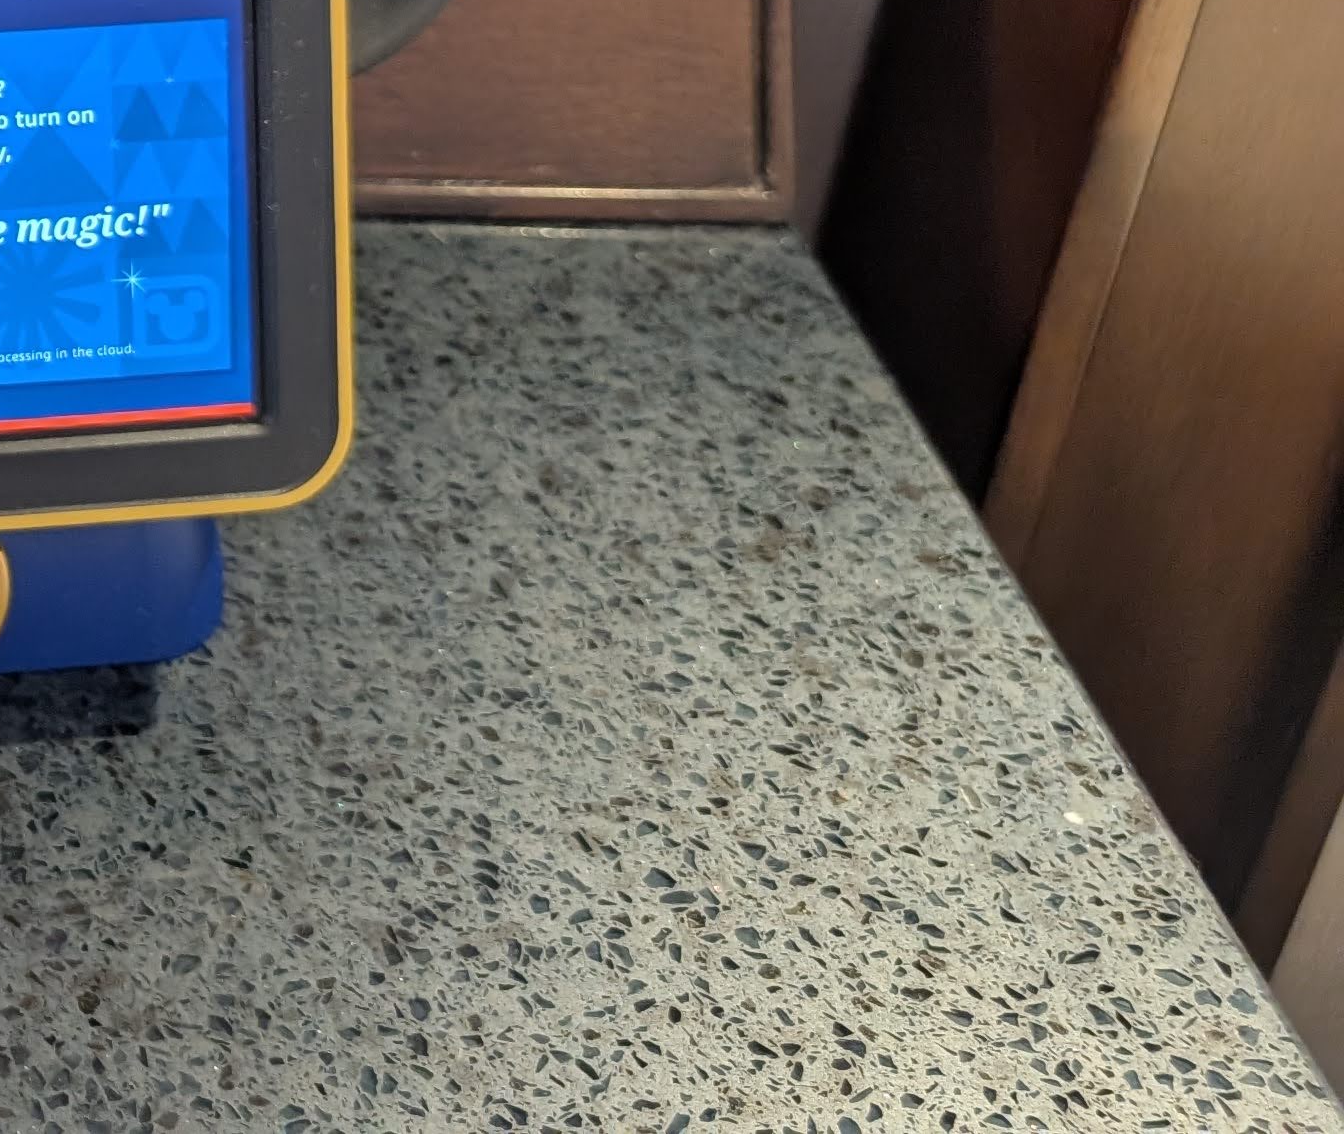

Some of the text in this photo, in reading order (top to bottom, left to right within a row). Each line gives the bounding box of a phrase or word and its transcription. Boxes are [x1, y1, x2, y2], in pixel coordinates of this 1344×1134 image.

[15, 109, 61, 129] turn
[67, 108, 95, 125] on
[16, 202, 171, 248] magic!"
[55, 346, 68, 360] in
[72, 344, 94, 359] the
[96, 342, 137, 358] cloud.
